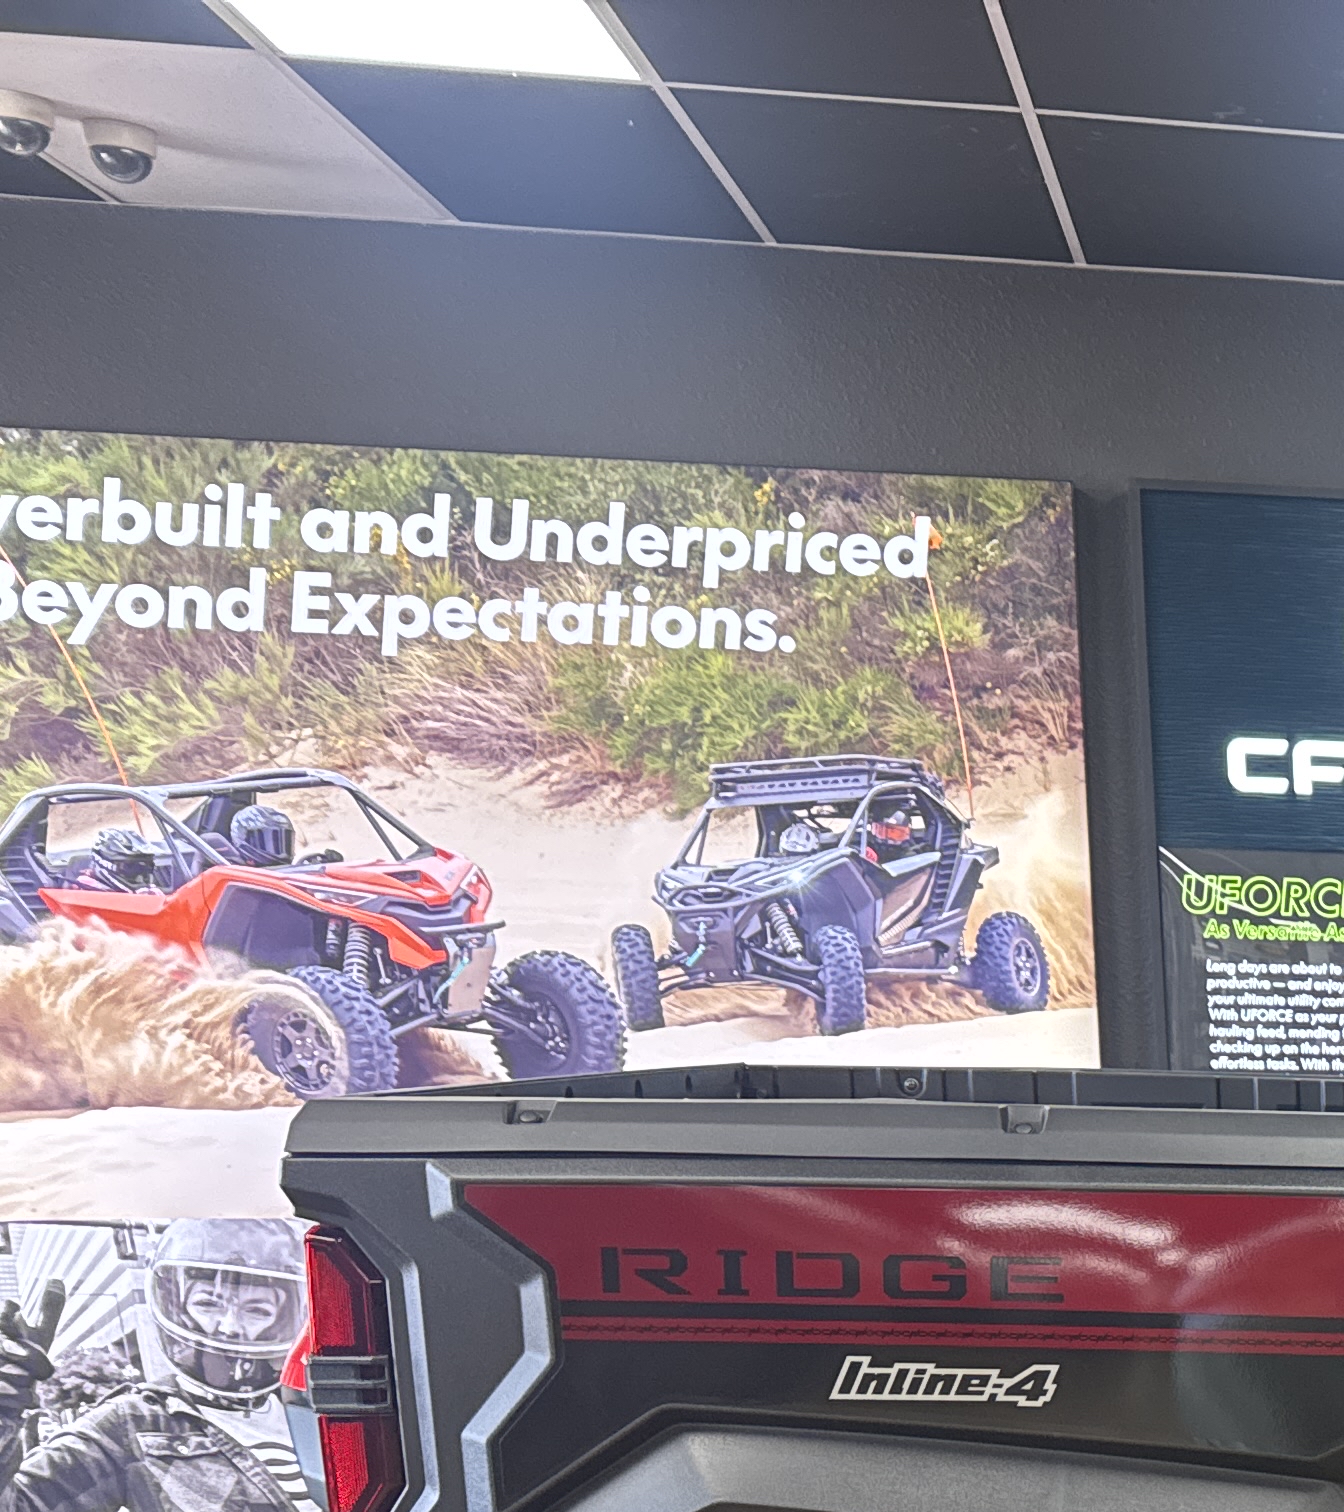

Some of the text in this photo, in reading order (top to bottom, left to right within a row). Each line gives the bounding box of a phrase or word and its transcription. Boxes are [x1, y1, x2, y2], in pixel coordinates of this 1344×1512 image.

[301, 493, 451, 558] and
[474, 497, 930, 588] Underpriced
[291, 570, 796, 657] Expectations.
[1204, 920, 1230, 939] As
[1206, 958, 1236, 975] Long
[1238, 959, 1267, 976] days
[1269, 964, 1290, 974] are
[1292, 961, 1328, 974] about
[1329, 963, 1342, 975] to
[1206, 976, 1271, 991] productive
[1287, 977, 1312, 990] and
[1207, 994, 1236, 1007] your
[1237, 992, 1286, 1006] ultimate
[1287, 993, 1321, 1010] utility
[1208, 1008, 1238, 1021] With
[1241, 1008, 1293, 1022] UFORCE
[1295, 1013, 1310, 1022] as
[1310, 1013, 1338, 1025] your
[1209, 1023, 1254, 1040] hauling
[1288, 1026, 1340, 1042] mending
[1209, 1040, 1263, 1057] checking
[1265, 1044, 1280, 1056] up
[1282, 1044, 1298, 1054] on
[1301, 1041, 1320, 1055] the
[1210, 1056, 1265, 1070] effortless
[1266, 1058, 1299, 1070] tasks.
[1300, 1058, 1330, 1071] With
[600, 1246, 1065, 1303] RIDGE
[828, 1355, 1061, 1407] Inline-4
